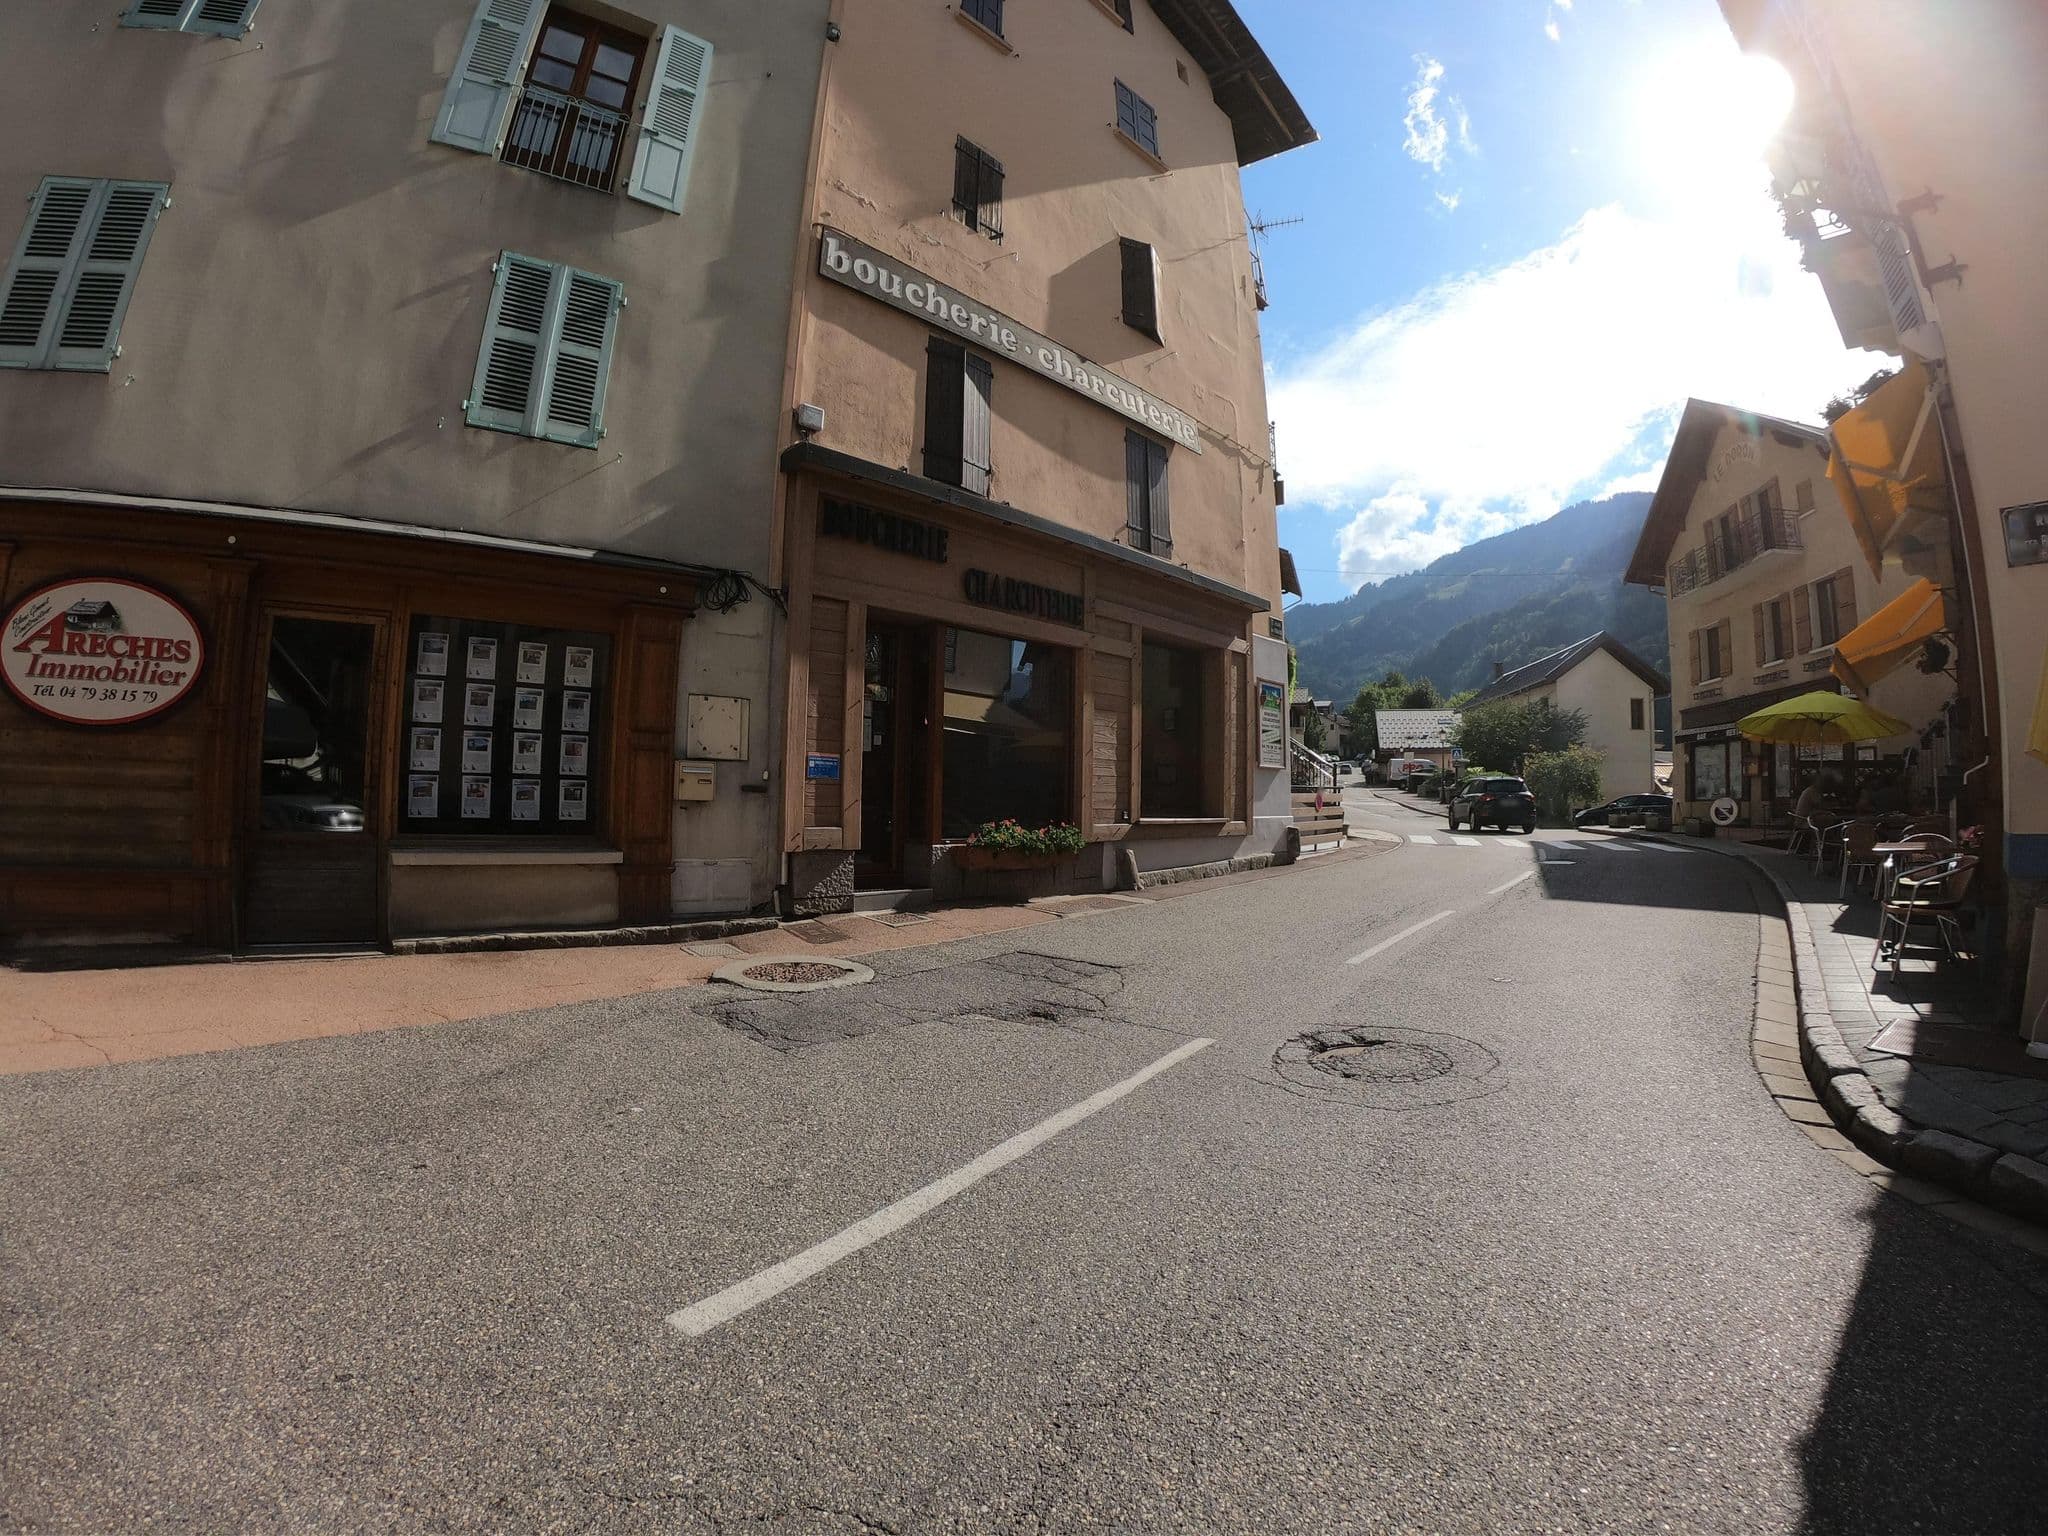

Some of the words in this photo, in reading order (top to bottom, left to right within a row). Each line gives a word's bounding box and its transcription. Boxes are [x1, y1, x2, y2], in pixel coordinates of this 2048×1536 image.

[824, 236, 1018, 351] boucherie
[1038, 347, 1198, 443] charcuterie
[823, 499, 948, 564] BOUCHERIE
[964, 567, 1084, 626] CHARCUTERIE
[13, 610, 192, 664] ARECHES
[24, 653, 187, 687] Immobilier
[32, 684, 55, 697] Tél.
[59, 685, 76, 699] 04
[81, 687, 97, 700] 79
[99, 688, 117, 701] 38
[121, 689, 137, 703] 15
[142, 690, 158, 704] 79
